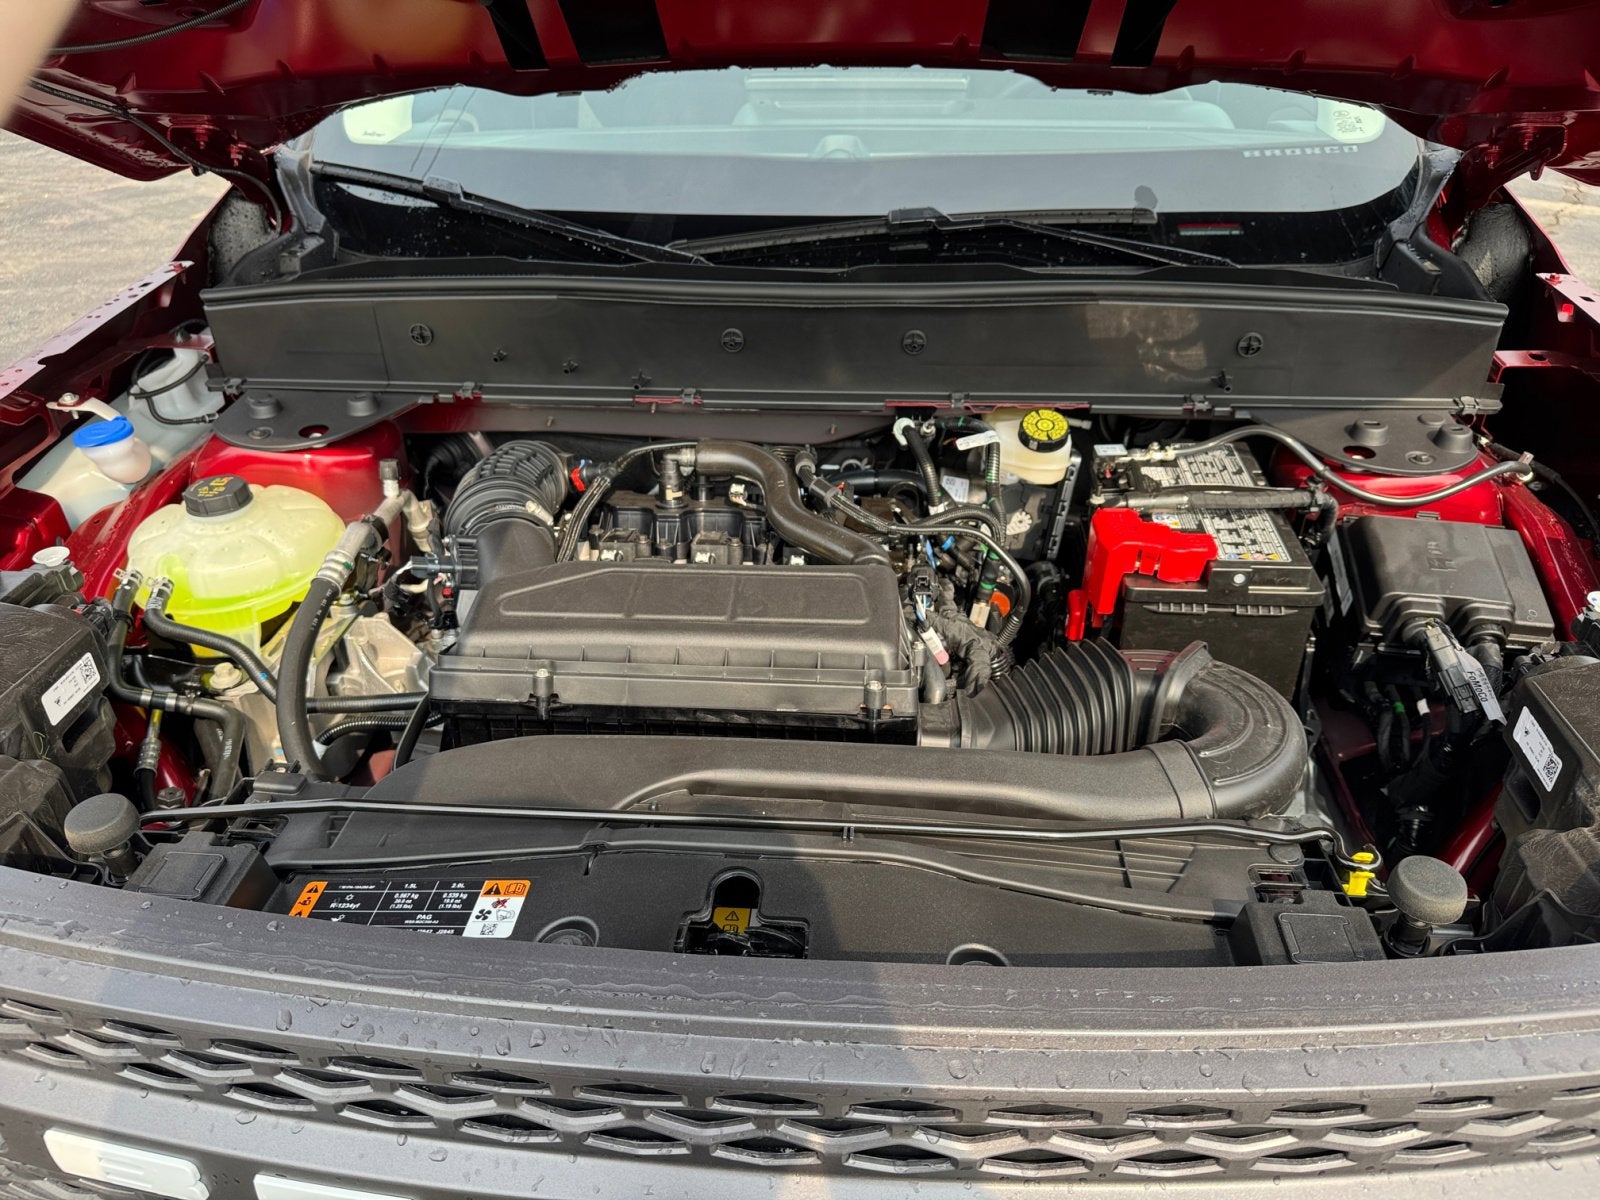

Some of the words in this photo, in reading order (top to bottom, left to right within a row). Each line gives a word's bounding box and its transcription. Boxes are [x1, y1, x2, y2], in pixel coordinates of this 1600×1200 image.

[1243, 145, 1359, 158] BRONCO
[1466, 671, 1489, 703] FoMoCo
[459, 892, 468, 900] kg
